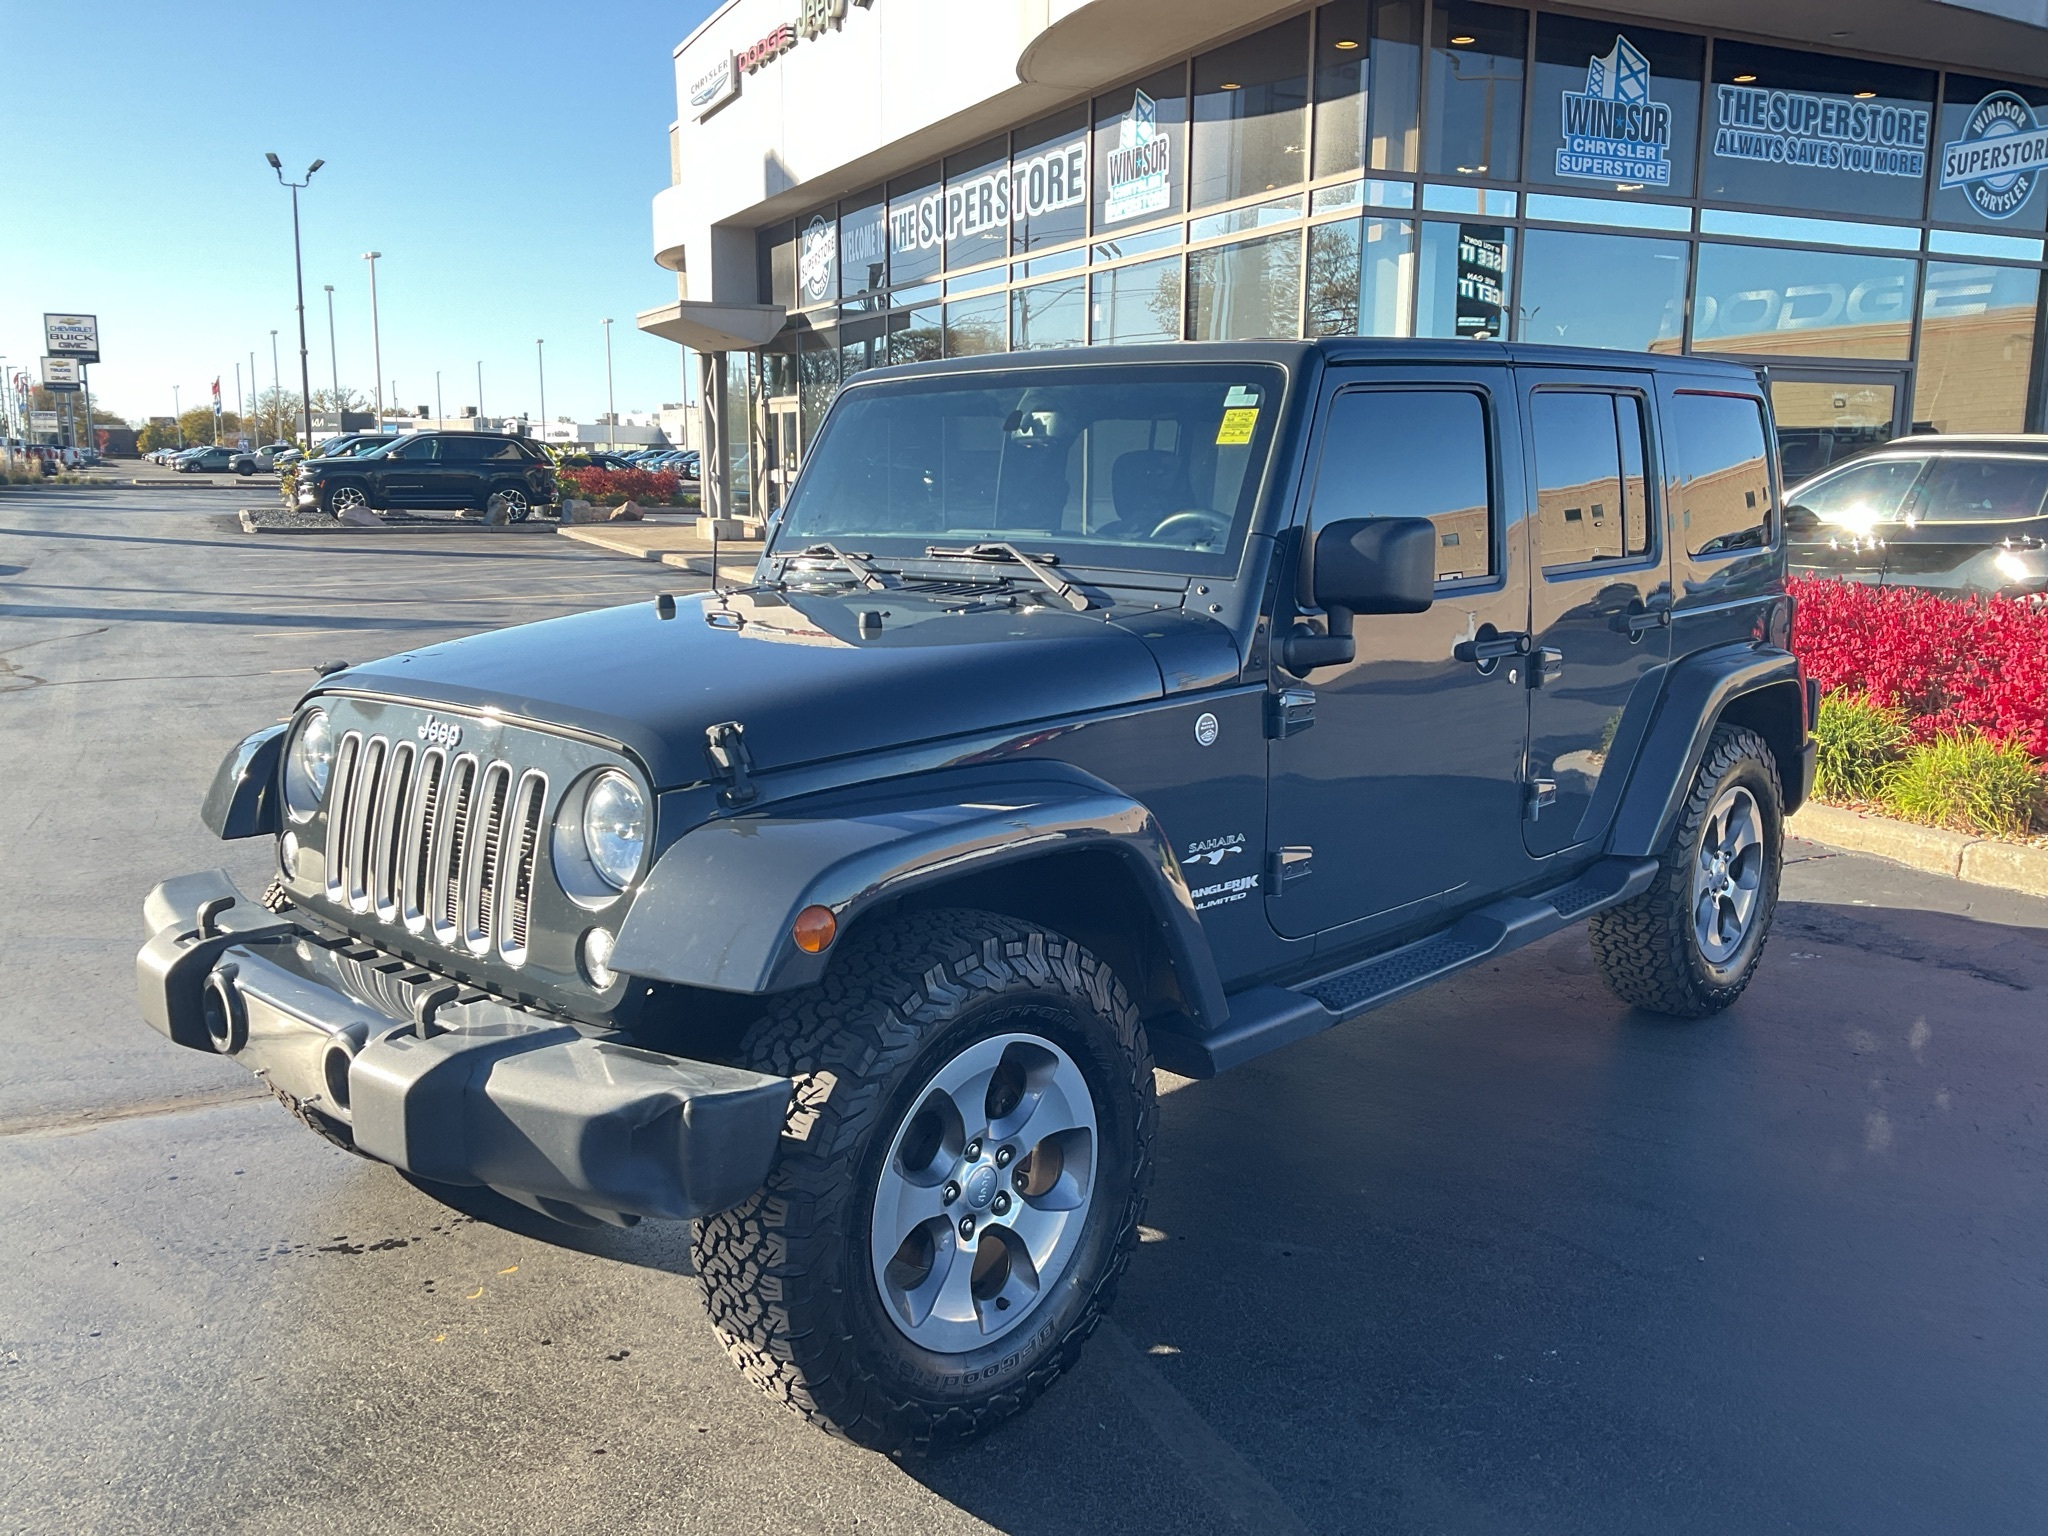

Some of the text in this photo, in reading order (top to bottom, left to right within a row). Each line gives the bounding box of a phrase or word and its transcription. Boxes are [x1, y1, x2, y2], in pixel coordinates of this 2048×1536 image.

[739, 23, 790, 72] DODGE
[690, 59, 729, 95] CHRYSLER
[1565, 95, 1669, 145] WINDSOR
[1721, 88, 1927, 146] THE SUPERSTORE
[1973, 101, 2027, 134] WINDSOR
[1109, 138, 1168, 187] WINDSOR
[1560, 155, 1667, 180] SUPERSTORE
[1573, 139, 1656, 160] CHRYSLER
[1716, 132, 1923, 175] ALWAYS SAVES YOU MORE!
[841, 222, 876, 265] WELCOME
[891, 207, 917, 250] THE
[921, 148, 1085, 245] SUPERSTORE
[1975, 176, 2029, 212] CHRYSLER
[801, 234, 836, 280] SUPERSTORE
[49, 333, 94, 342] BUICK
[418, 714, 462, 751] Jeep
[1188, 832, 1247, 854] SAHARA
[1195, 891, 1247, 911] NLIMITED
